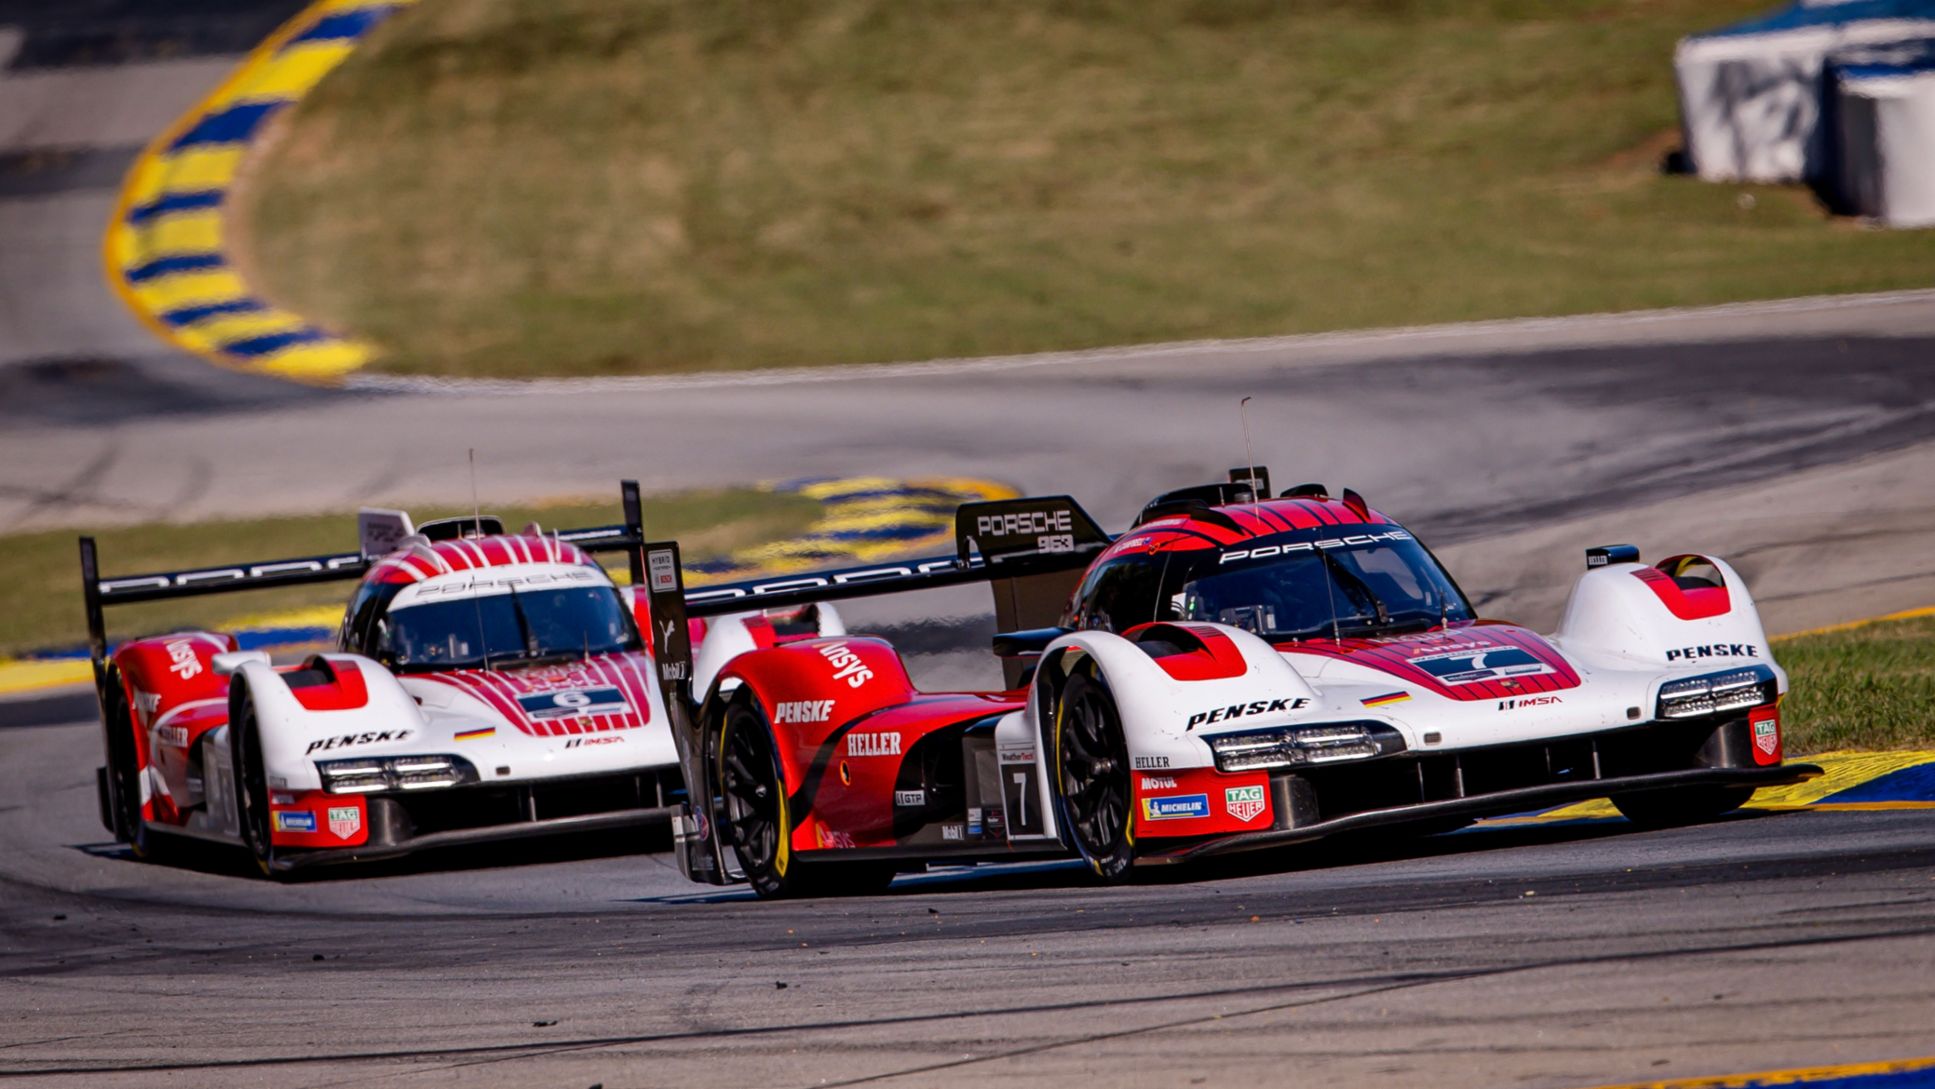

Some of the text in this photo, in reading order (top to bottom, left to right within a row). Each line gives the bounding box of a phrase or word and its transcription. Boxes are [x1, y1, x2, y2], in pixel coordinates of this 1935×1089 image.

[977, 510, 1073, 536] PORSCHE
[1037, 535, 1075, 553] 963
[1219, 530, 1412, 565] PORSCHE
[415, 571, 594, 597] PORSCHE
[1448, 652, 1488, 670] 7
[1665, 643, 1759, 661] PENSKE
[662, 663, 679, 680] Mobil
[552, 691, 591, 708] 6
[1518, 696, 1563, 708] IMSA
[774, 700, 835, 724] PENSKE
[1186, 697, 1312, 732] PENSKE
[1757, 721, 1776, 735] TAG
[305, 729, 414, 756] PENSKE
[847, 732, 901, 757] HELLER
[1135, 756, 1171, 769] HELLER
[1141, 776, 1177, 790] MOTUL
[904, 793, 923, 804] GTP
[1012, 772, 1027, 827] 7
[1228, 788, 1262, 801] TAG
[1160, 801, 1202, 813] MICHELIN
[1229, 801, 1264, 819] HEUER
